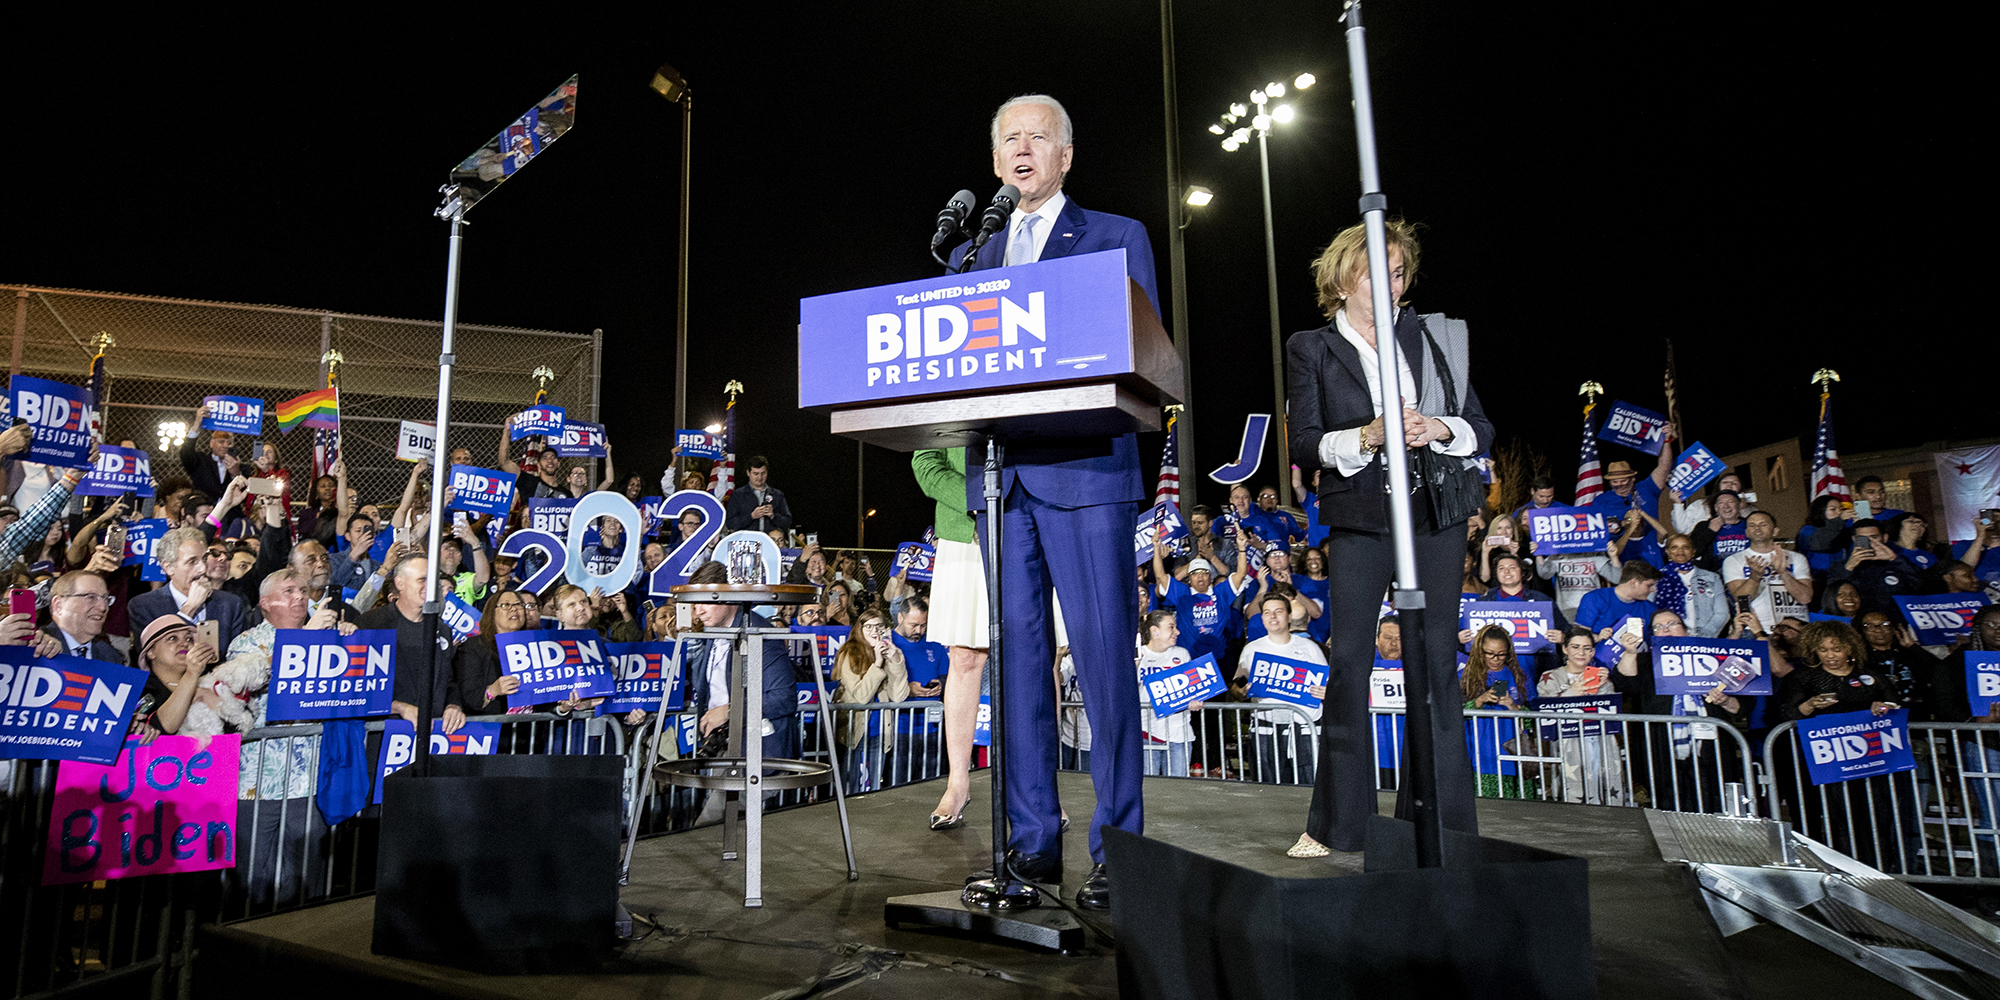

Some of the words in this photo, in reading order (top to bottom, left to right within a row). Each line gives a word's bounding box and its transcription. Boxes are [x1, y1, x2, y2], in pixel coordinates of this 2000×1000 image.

[896, 294, 919, 306] Text
[920, 286, 963, 302] UNITED
[963, 284, 976, 296] to
[976, 279, 1011, 293] 30330
[866, 291, 1047, 365] BIDEN
[867, 347, 1047, 387] PRESIDENT
[18, 390, 93, 433] BIDEN
[206, 400, 260, 418] BIDEN
[210, 412, 259, 425] RESIDENT
[513, 410, 562, 424] BIDEN
[548, 430, 602, 446] BIDEN
[1608, 414, 1663, 442] BIDEN
[409, 434, 436, 451] BID
[678, 434, 723, 447] BIDEN
[1208, 413, 1271, 485] J
[97, 453, 151, 476] IDEN
[1668, 448, 1711, 488] BIDEN
[82, 471, 151, 484] RESIDENT
[453, 472, 512, 496] BIDEN
[1533, 513, 1605, 534] BIDEN
[1536, 531, 1606, 542] PRESIDENT
[1558, 562, 1579, 574] JOE
[1773, 591, 1803, 606] BID
[1906, 602, 1961, 610] CALIFORNIA
[441, 600, 481, 637] BID
[1469, 610, 1521, 618] CALIFORNIA
[1910, 609, 1978, 630] BIDE
[1469, 619, 1547, 638] BDEN
[505, 640, 603, 672] BIDEN
[788, 635, 846, 656] IDEN
[1660, 645, 1727, 655] CALIFORNIA
[1729, 648, 1753, 656] FOR
[278, 644, 391, 679] BIDEN
[1660, 654, 1762, 677] BIDN
[1148, 661, 1217, 699] BIDEN
[1253, 660, 1324, 686] BIDEN
[276, 678, 389, 694] PRESIDENT
[546, 685, 567, 693] UNITED
[616, 681, 680, 692] ESIDENT
[1155, 676, 1218, 706] PRESIDENT
[1252, 677, 1311, 693] PRESIDEN
[314, 699, 340, 708] UNITED
[1539, 702, 1592, 710] CALIFORNIA
[2, 709, 118, 735] ESIDENT
[1808, 723, 1872, 739] CALIFORNIA
[1873, 719, 1892, 728] FOR
[0, 735, 82, 748] WW.JOEBIDEN.COM
[1810, 727, 1904, 765] BIDEN
[100, 738, 214, 804] Joe
[60, 800, 233, 875] Biden
